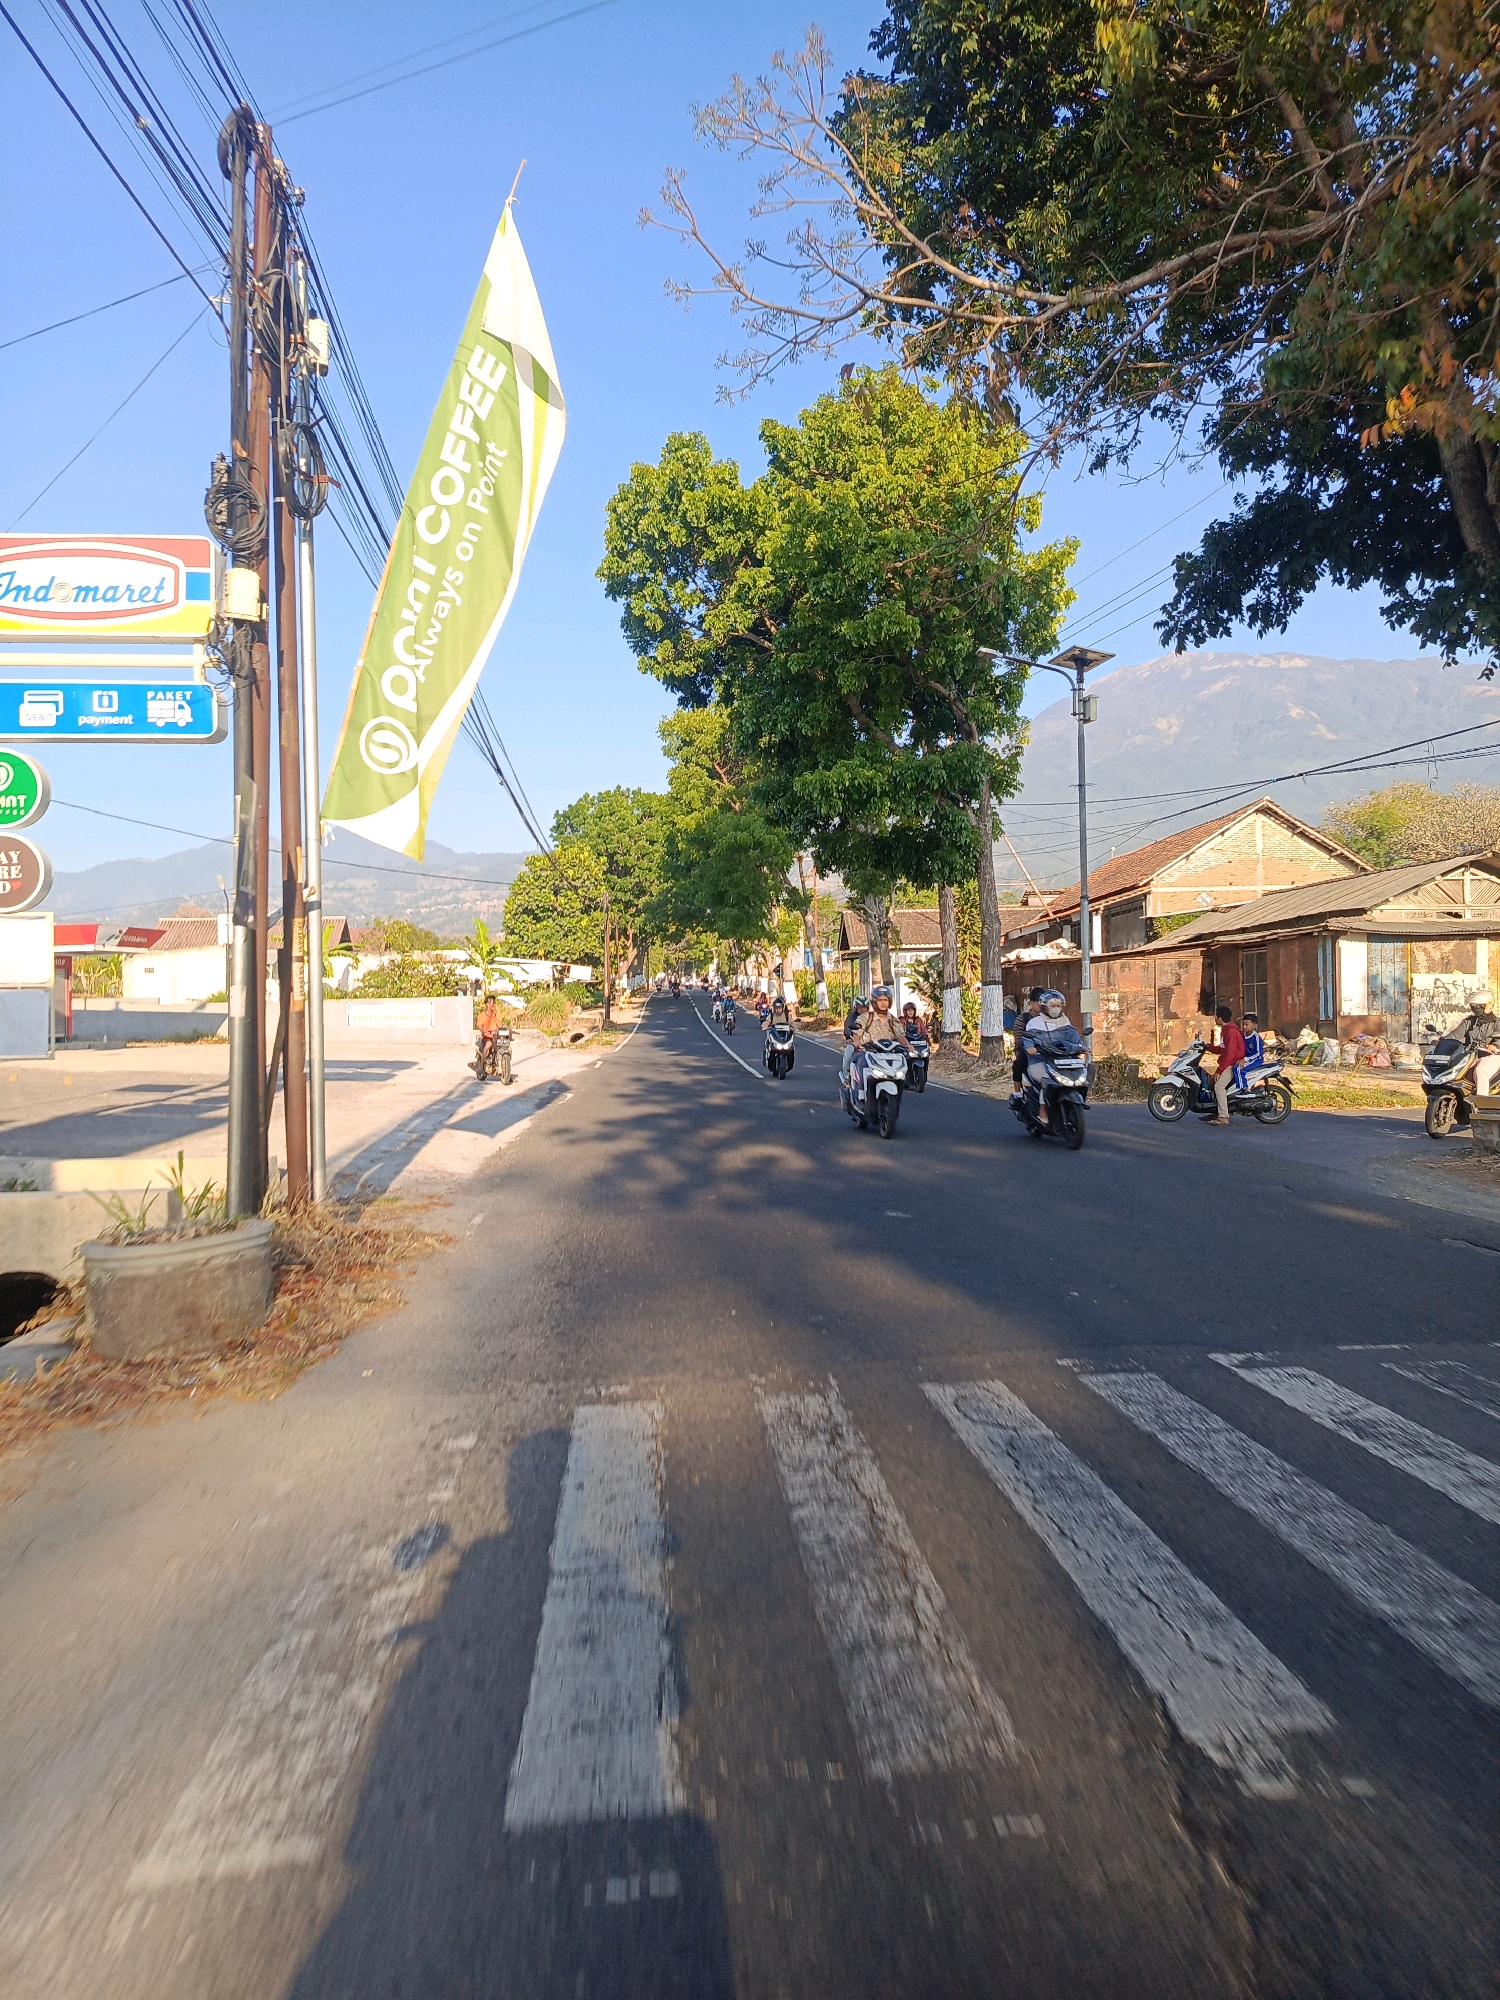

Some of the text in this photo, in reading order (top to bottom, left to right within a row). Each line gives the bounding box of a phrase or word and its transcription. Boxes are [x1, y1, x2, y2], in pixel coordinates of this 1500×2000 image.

[416, 345, 507, 545] COFFEE
[414, 441, 508, 684] Always on Point
[0, 571, 166, 603] Indomaret
[147, 690, 193, 700] PAKET
[25, 713, 53, 722] DEBIT
[77, 713, 134, 726] payment
[0, 850, 22, 864] AY
